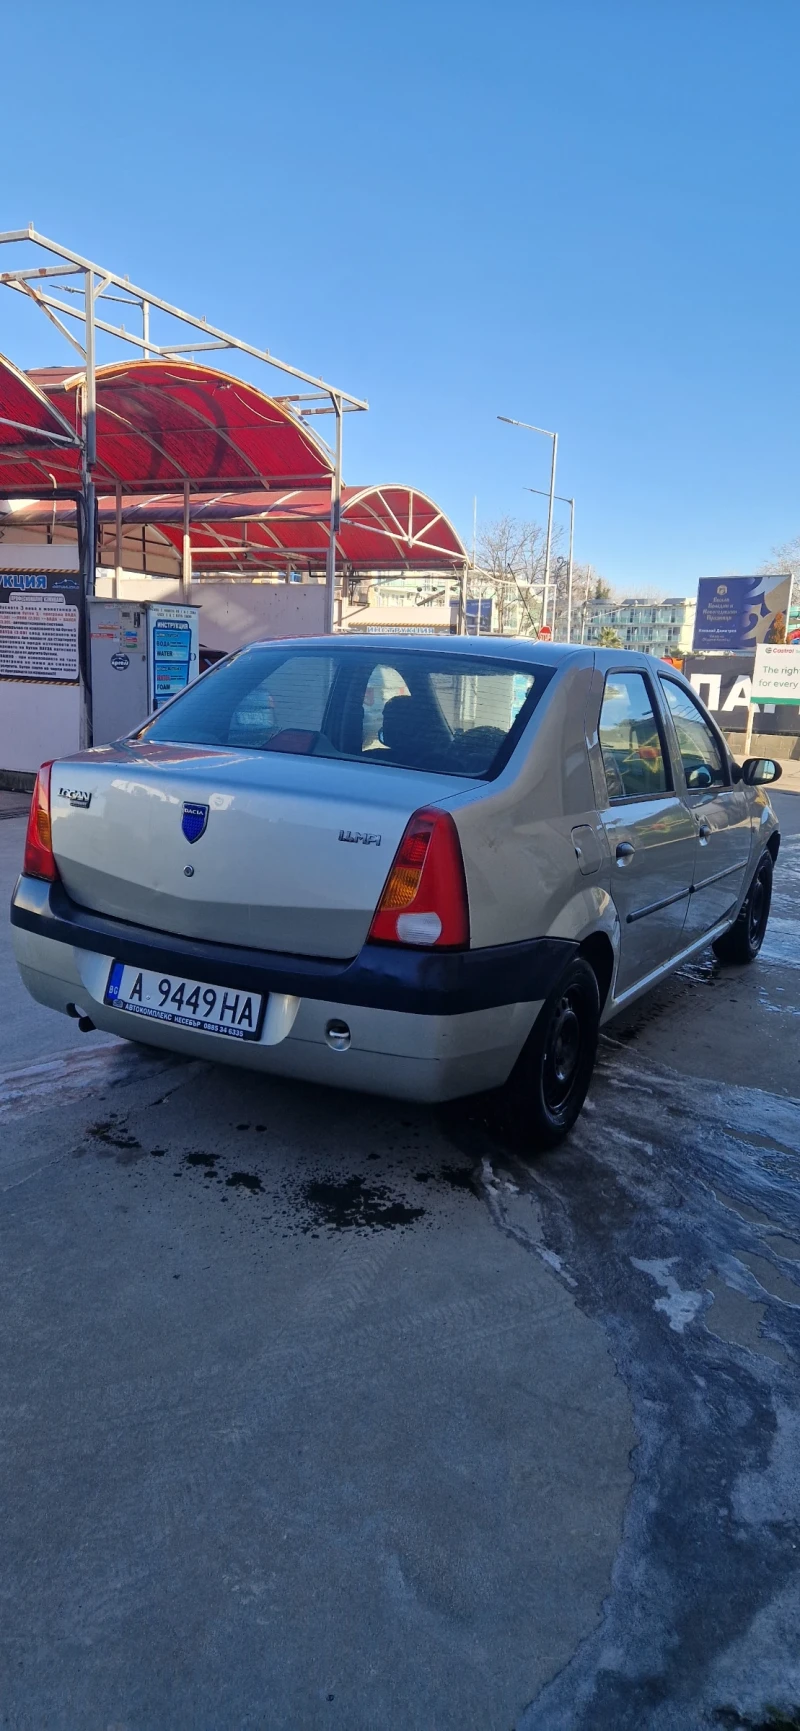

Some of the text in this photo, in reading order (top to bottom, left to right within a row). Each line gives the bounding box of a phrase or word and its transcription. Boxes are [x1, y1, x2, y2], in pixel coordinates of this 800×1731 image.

[763, 666, 779, 674] The
[774, 681, 799, 689] every
[184, 808, 204, 816] DACIA
[109, 986, 119, 995] BG
[125, 1003, 172, 1021] АВТОКОМПЛЕКС
[174, 1016, 201, 1027] НЕСЕБЪР
[203, 1023, 219, 1032] 0885
